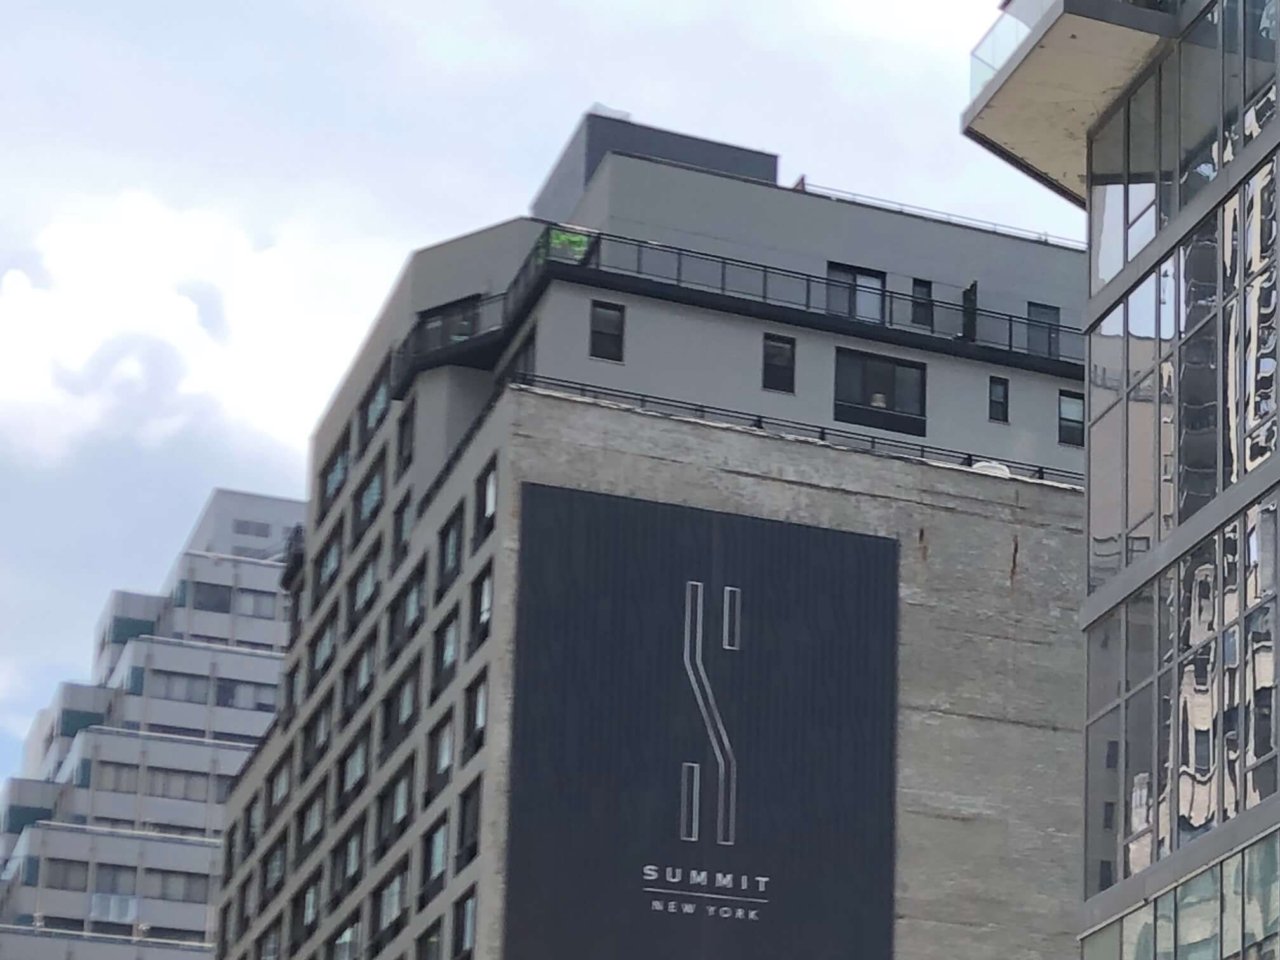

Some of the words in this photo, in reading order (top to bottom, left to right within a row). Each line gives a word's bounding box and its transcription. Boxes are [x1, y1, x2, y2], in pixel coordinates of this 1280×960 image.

[643, 865, 770, 891] SUMMIT
[652, 900, 696, 915] NEW
[707, 906, 760, 921] YORK
